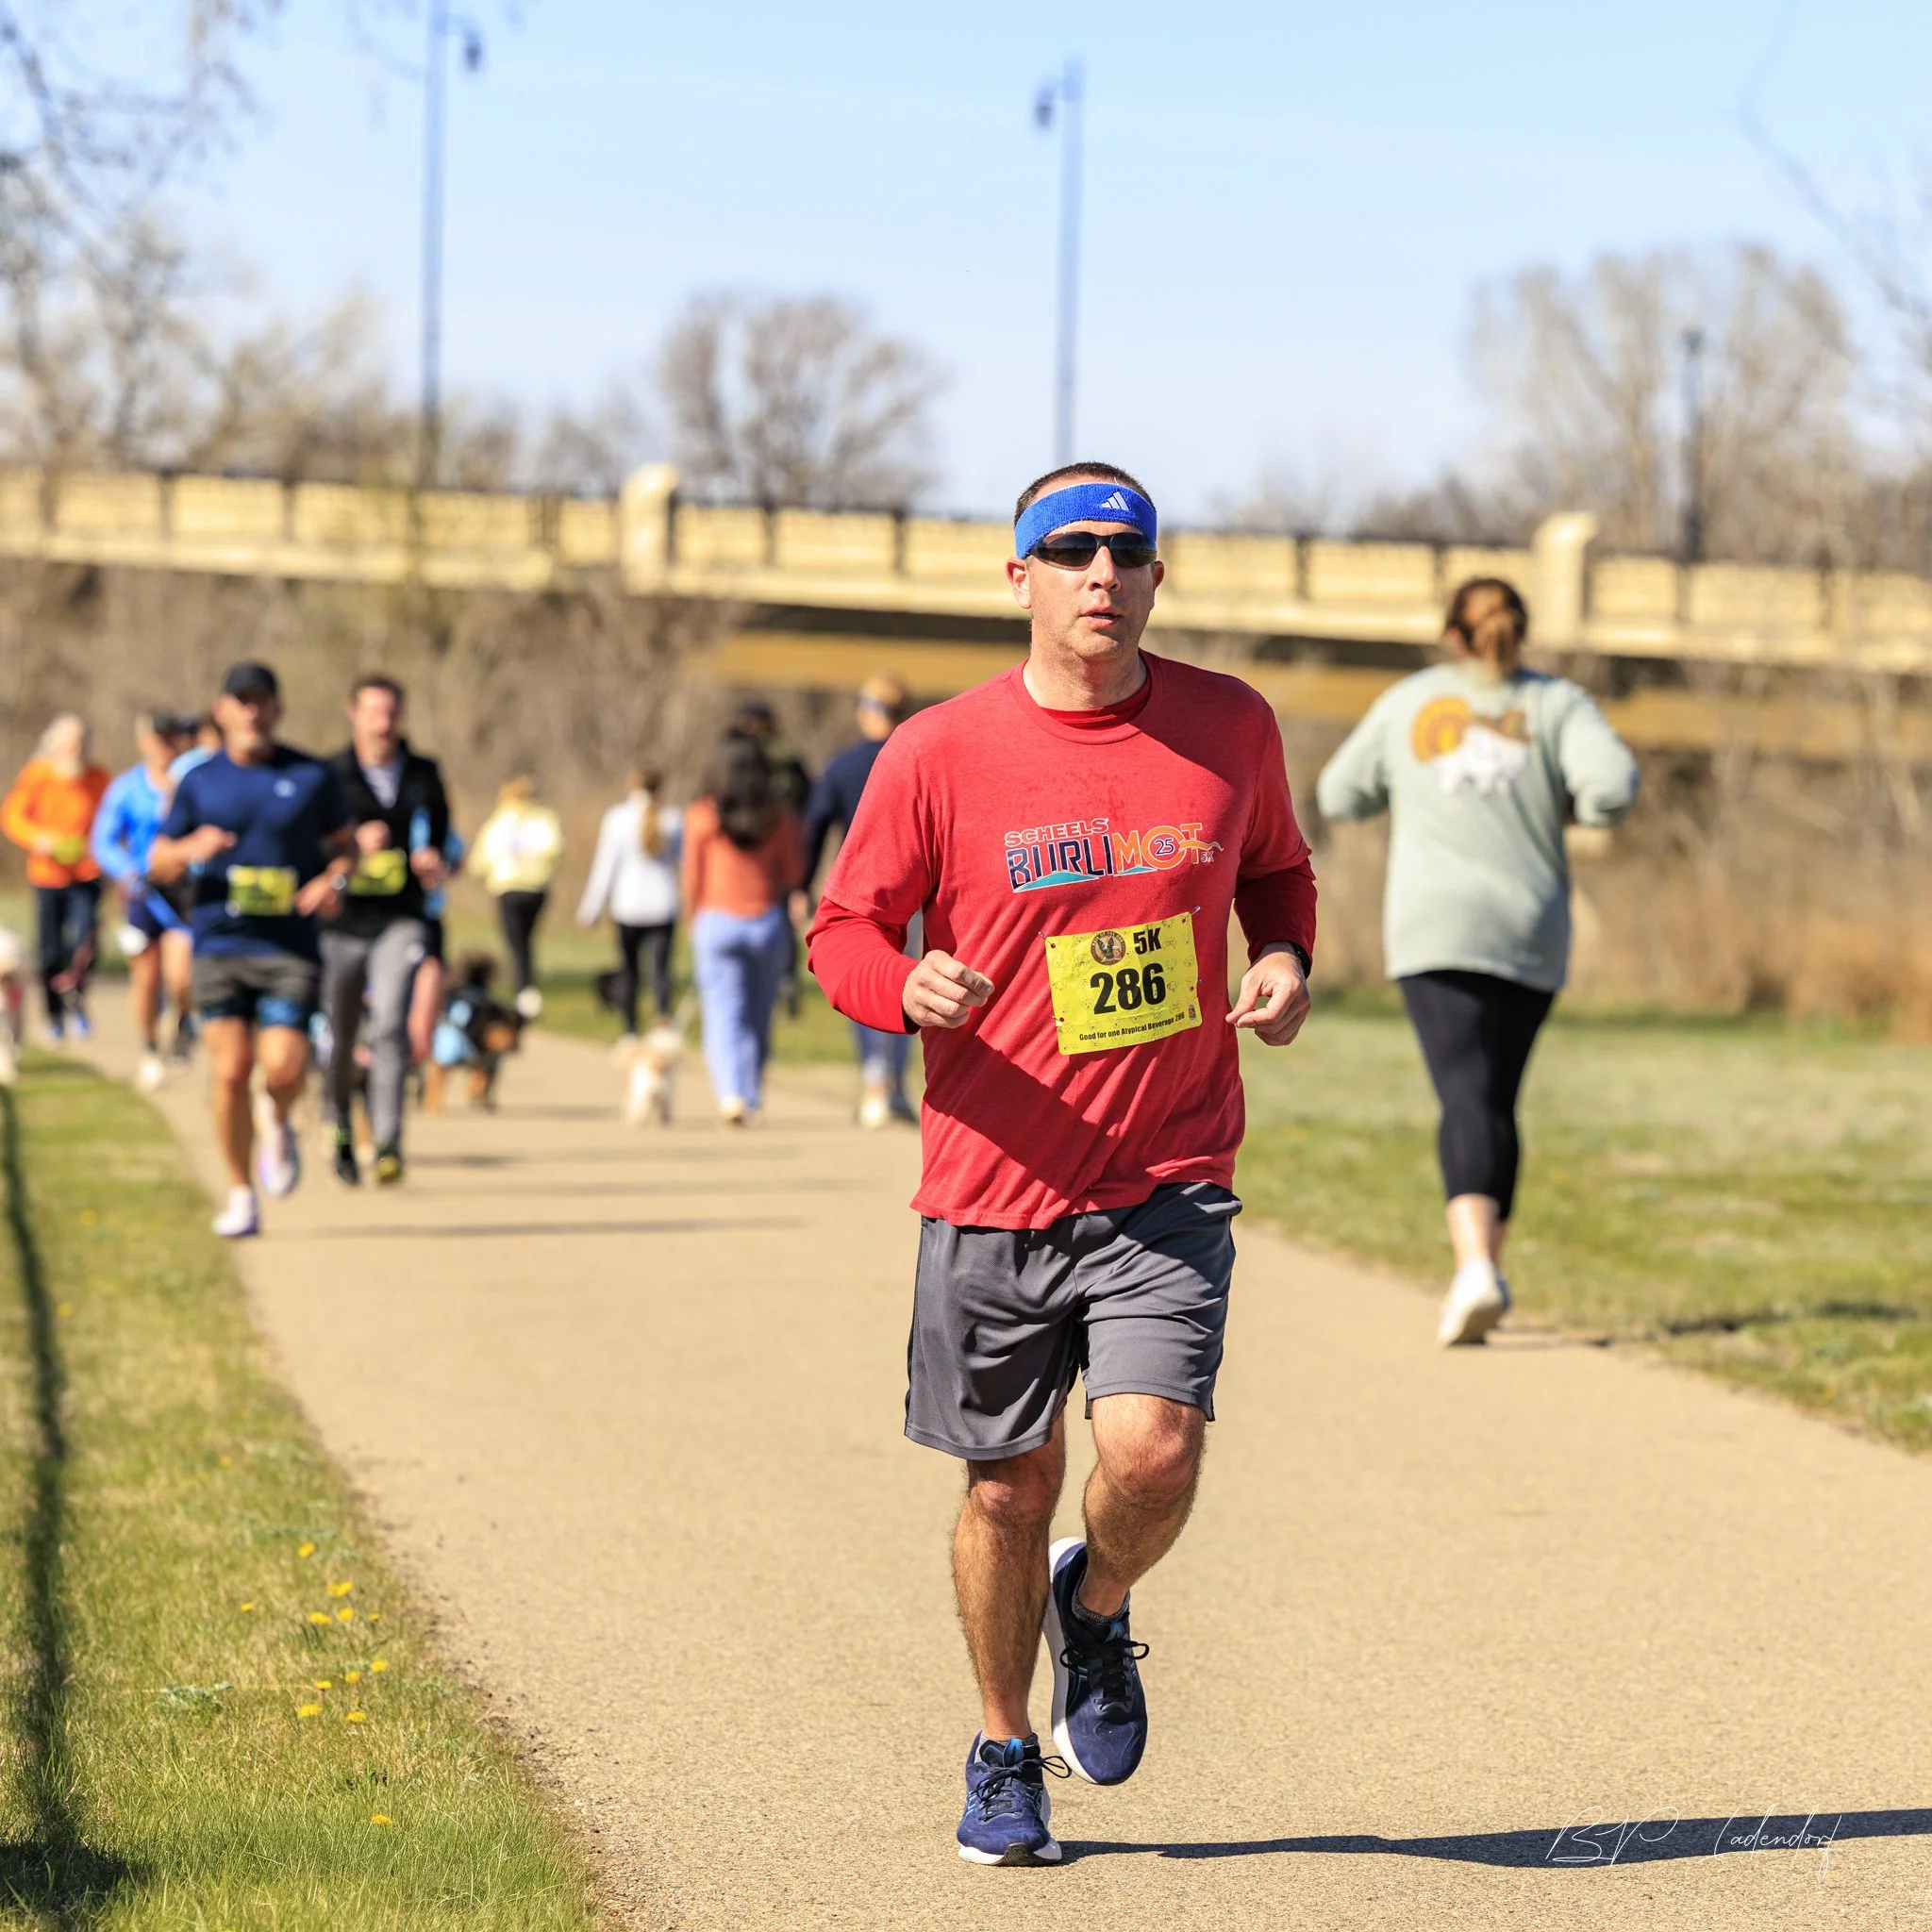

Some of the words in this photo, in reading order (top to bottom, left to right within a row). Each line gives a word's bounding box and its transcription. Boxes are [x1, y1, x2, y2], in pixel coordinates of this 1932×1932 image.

[1005, 818, 1108, 847] SCHEELS
[1155, 839, 1175, 856] 25
[1200, 850, 1214, 862] 5K
[1133, 927, 1163, 955] 5K
[1090, 962, 1166, 1014] 286
[1121, 1024, 1147, 1035] Atypical
[1148, 1017, 1174, 1030] Beverage
